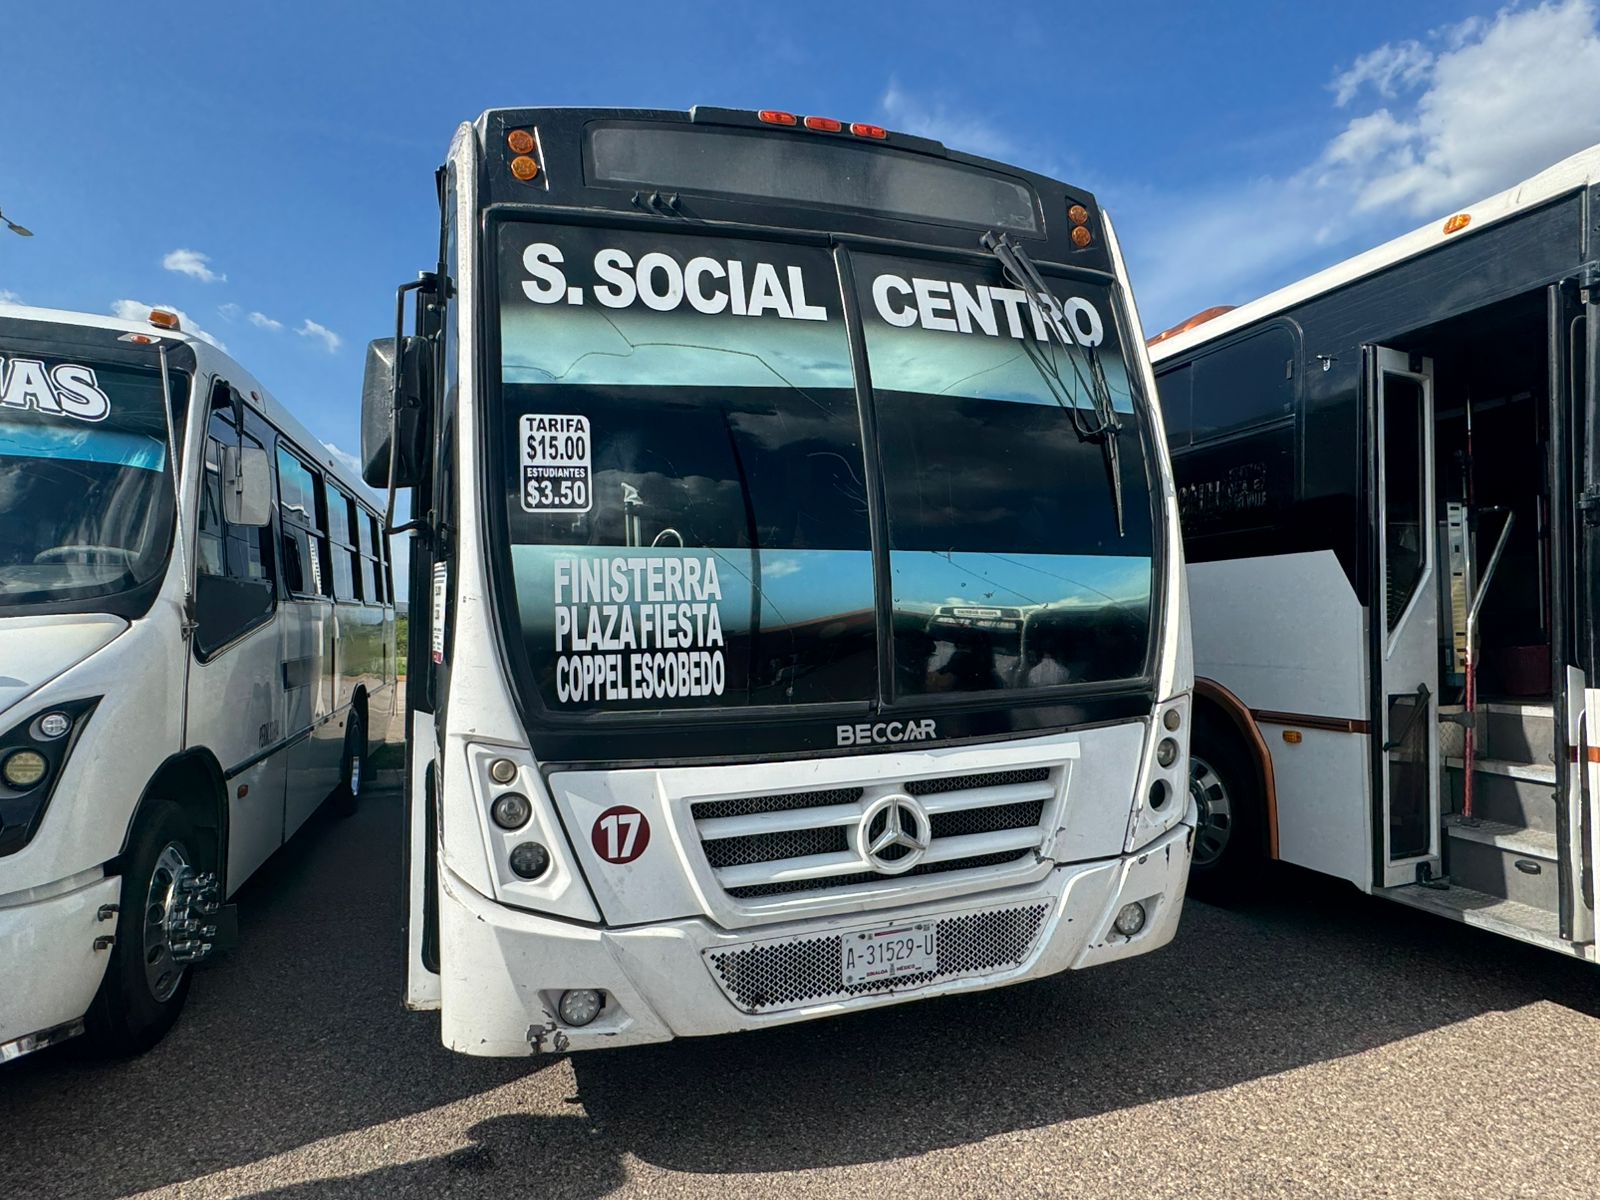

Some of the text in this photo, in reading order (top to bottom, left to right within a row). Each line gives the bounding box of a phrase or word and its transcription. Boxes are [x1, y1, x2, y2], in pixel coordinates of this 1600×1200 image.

[521, 243, 828, 321] S. SOCIAL
[872, 274, 1103, 347] CENTRO
[526, 418, 585, 433] TARIFA
[527, 435, 585, 462] $15.00
[527, 467, 585, 478] ESTUDIANTES
[527, 480, 585, 507] $3.50
[554, 557, 722, 603] FINISTERRA
[555, 603, 723, 652] PLAZA FIESTA
[556, 651, 725, 703] COPPEL ESCOBEDO
[837, 719, 936, 746] BECCAR
[600, 813, 641, 858] 17
[846, 934, 933, 969] A-31529-U
